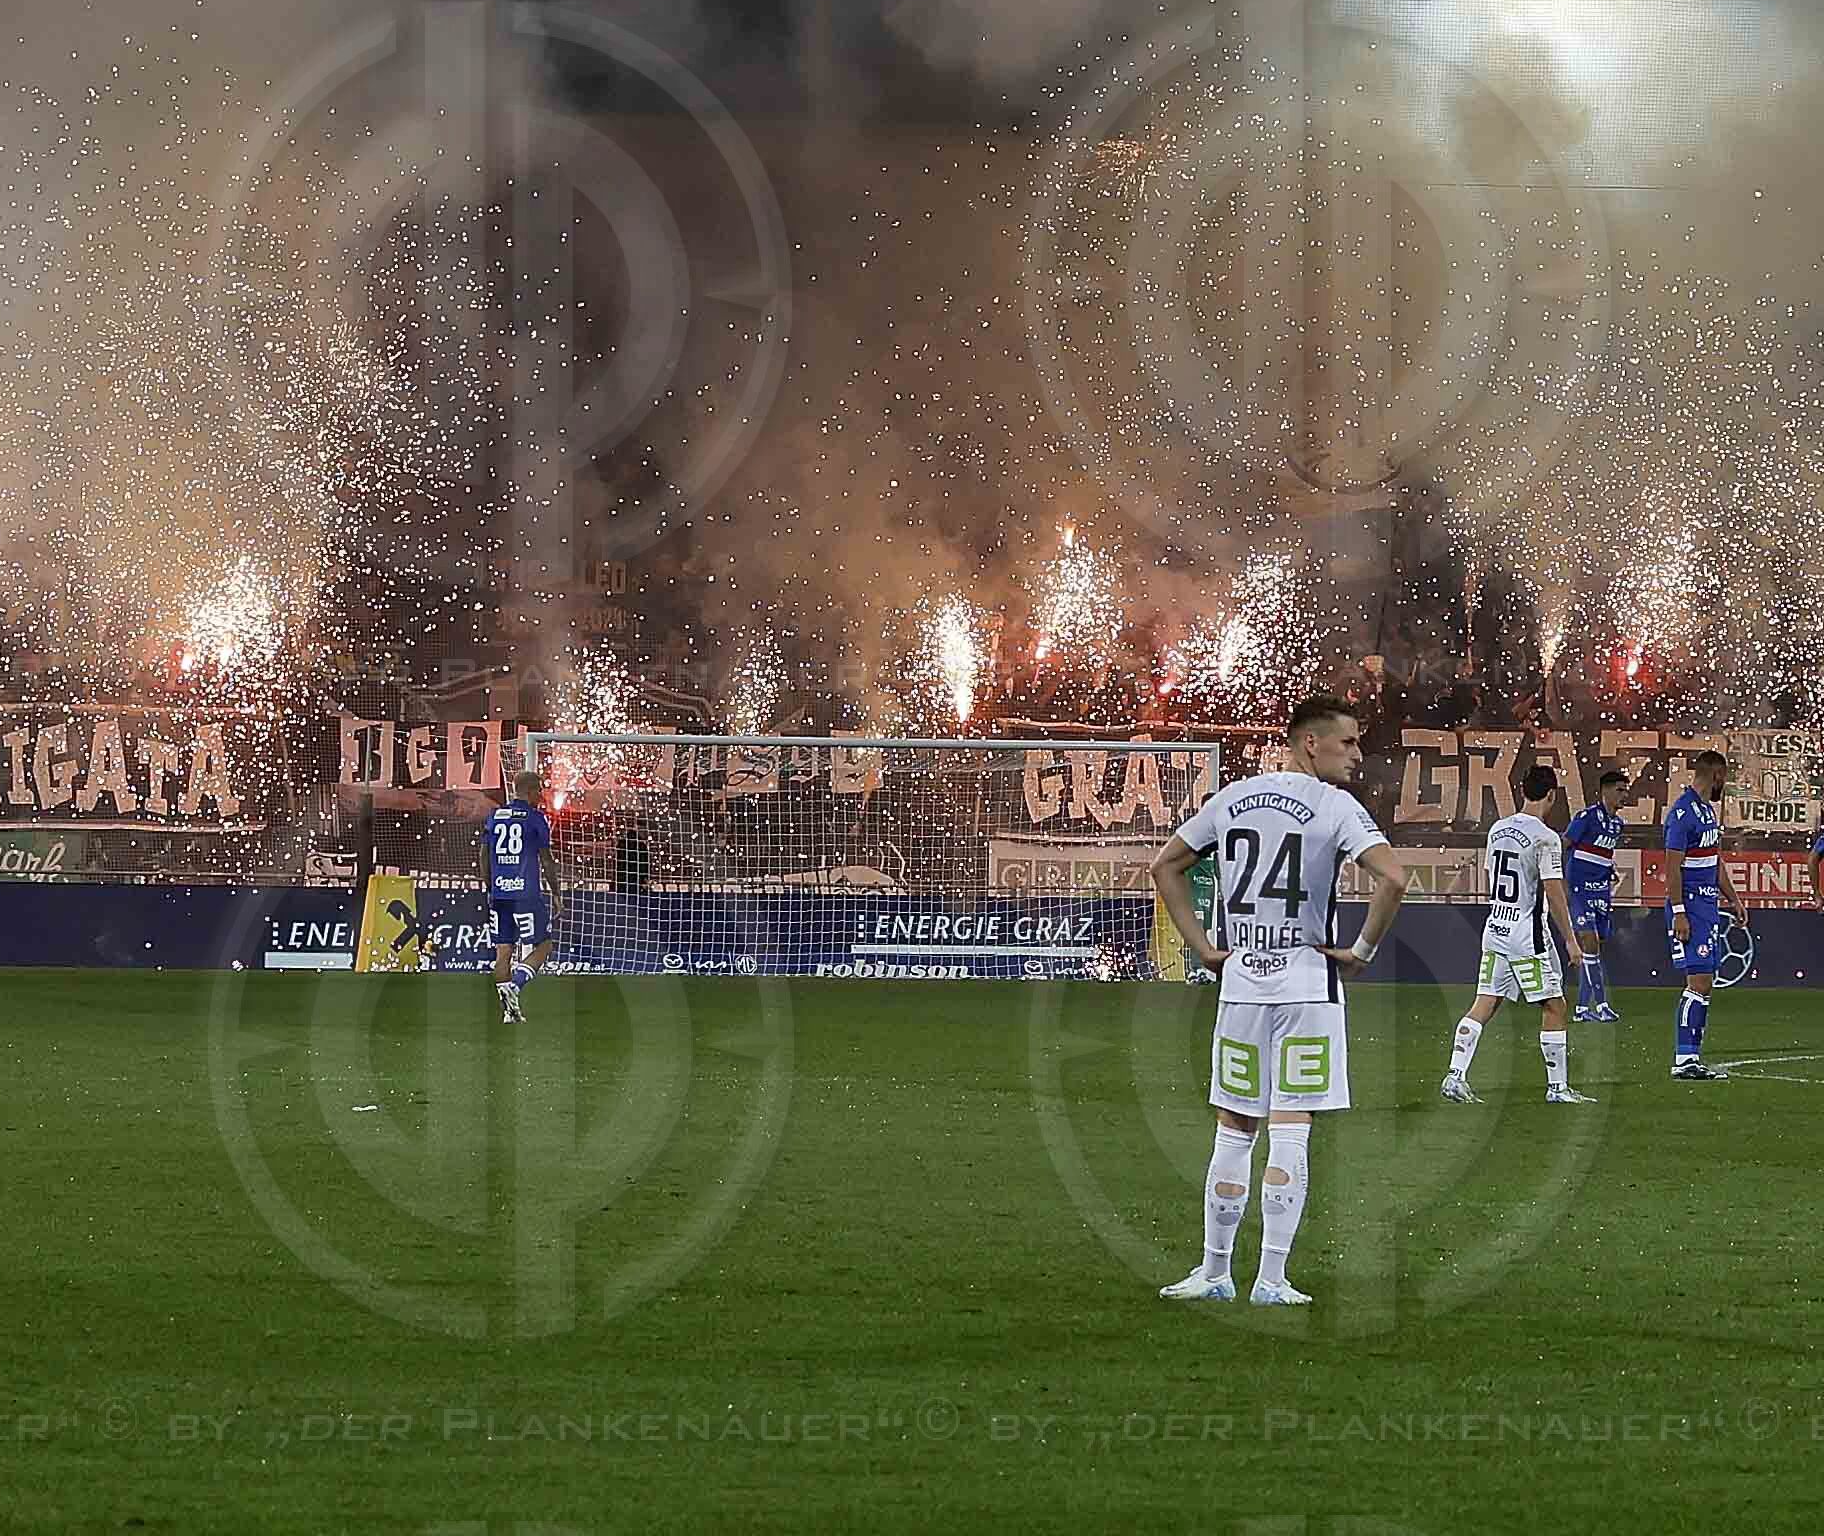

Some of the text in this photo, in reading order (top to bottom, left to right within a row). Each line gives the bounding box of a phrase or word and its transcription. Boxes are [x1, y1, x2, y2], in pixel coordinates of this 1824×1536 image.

[1231, 792, 1314, 825] PUNTIGAMER
[1738, 799, 1808, 823] VERDE
[493, 823, 523, 855] 28
[1225, 828, 1309, 919] 24
[1490, 849, 1520, 904] 15
[873, 915, 1095, 942] ENERGIE GRAZ
[815, 958, 969, 979] robinson
[1241, 952, 1288, 975] Grapos
[1286, 1044, 1325, 1086] E
